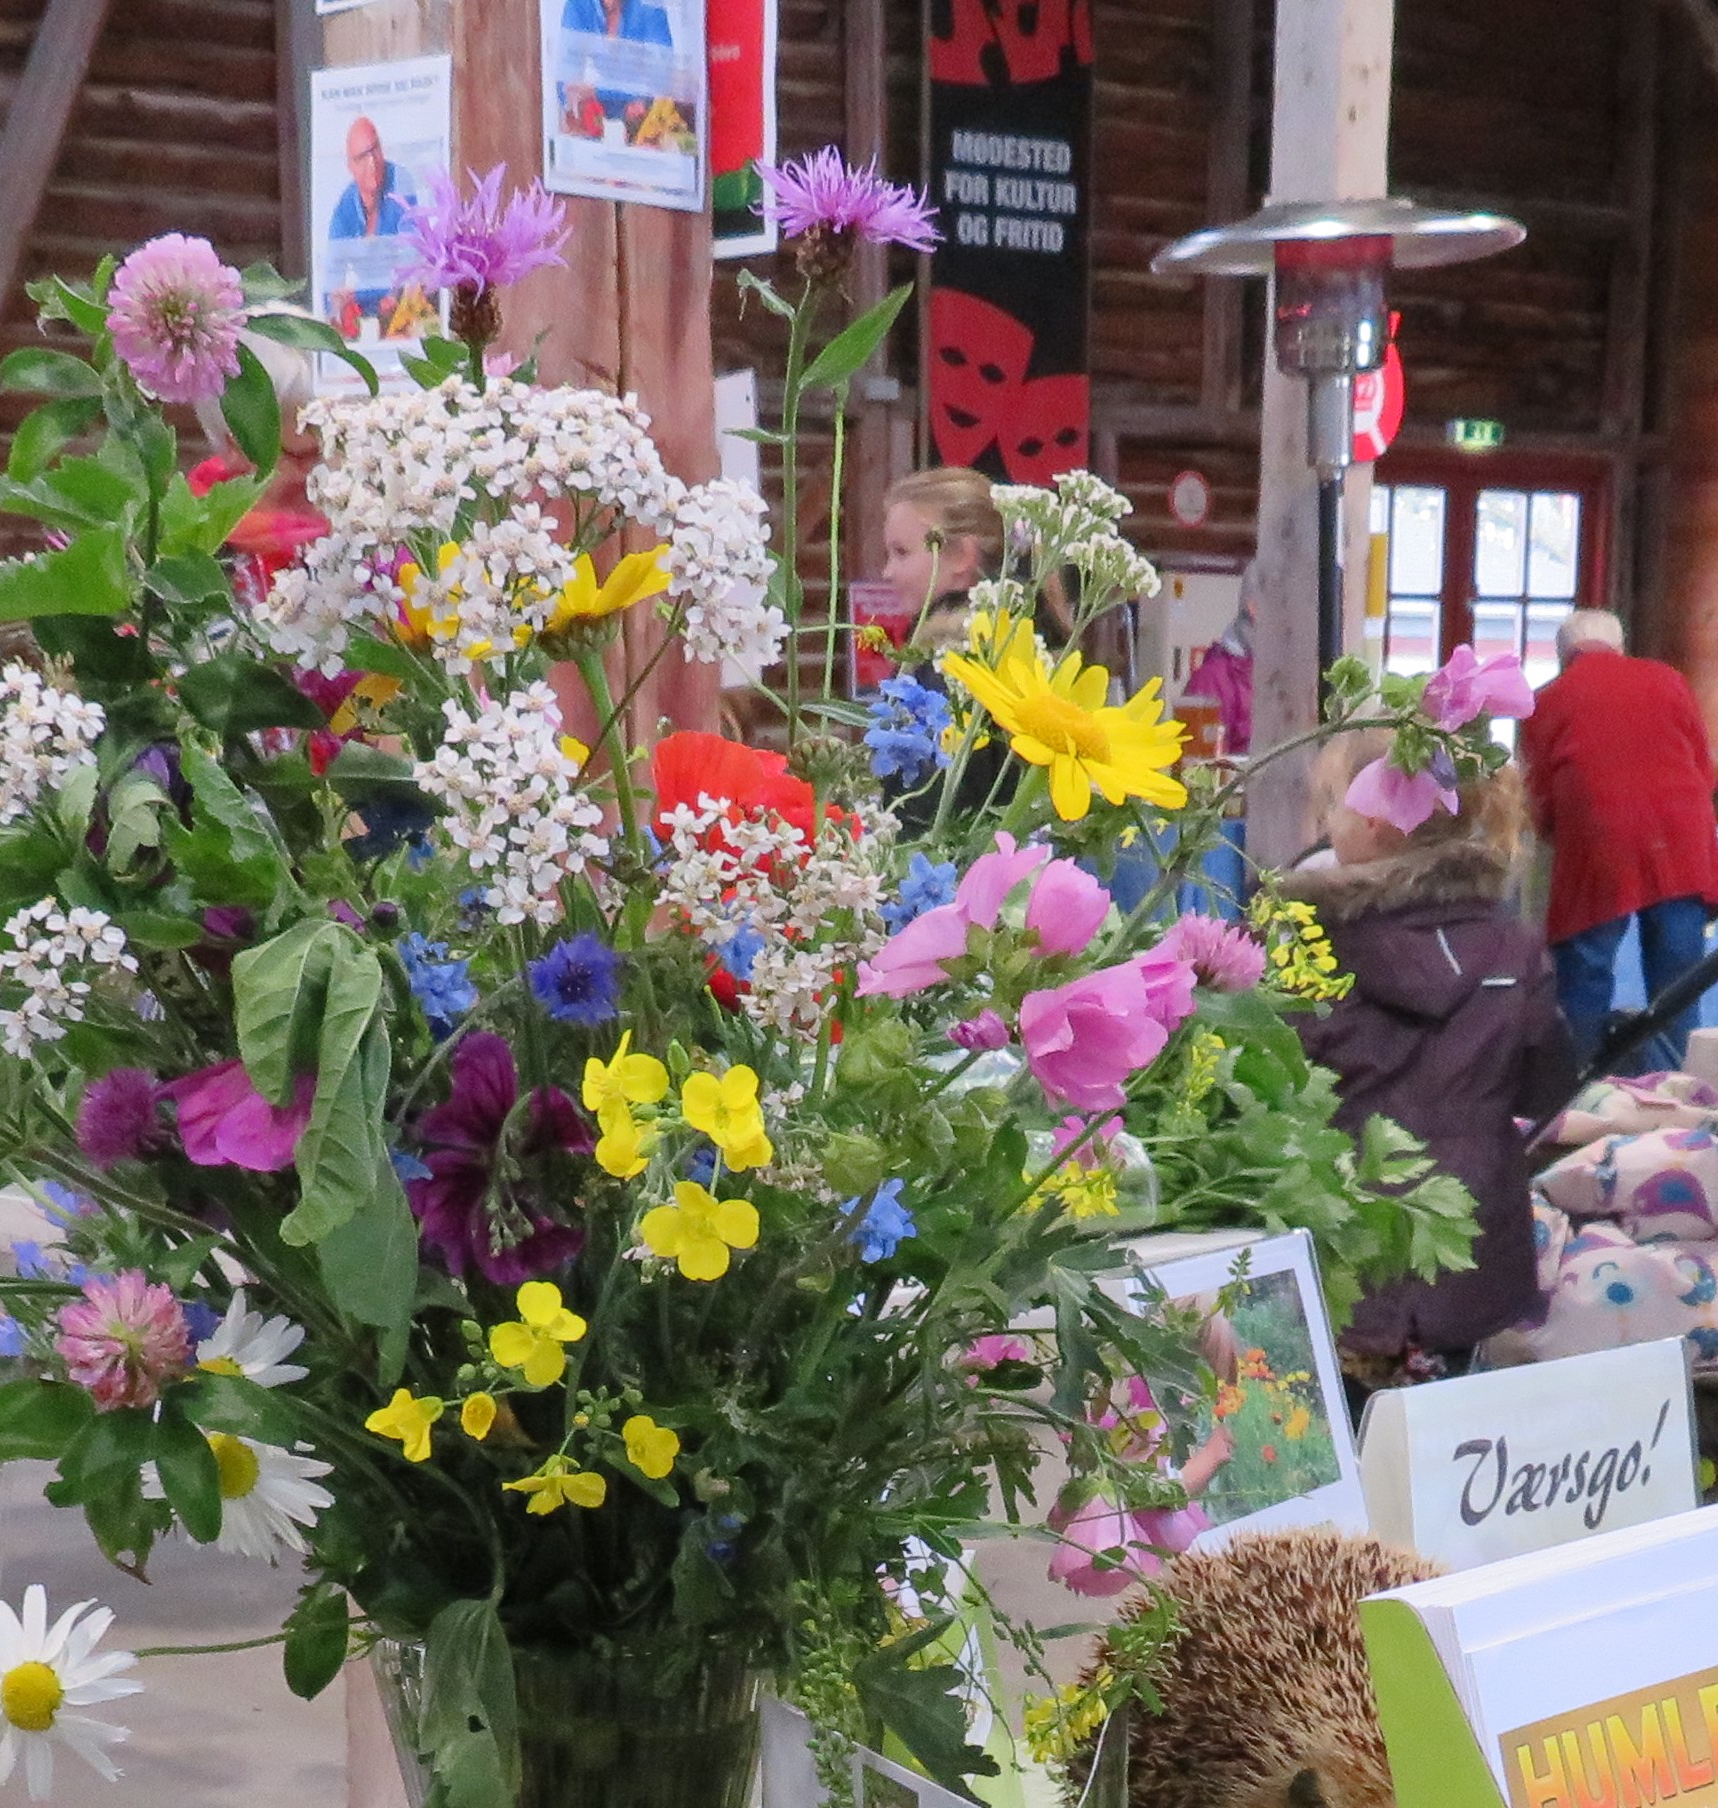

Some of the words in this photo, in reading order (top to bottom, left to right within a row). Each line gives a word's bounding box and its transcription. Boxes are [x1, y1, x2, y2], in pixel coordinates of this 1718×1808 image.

[945, 169, 989, 206] FOR
[995, 177, 1077, 215] KULTUR
[957, 213, 988, 245] OG
[1453, 1398, 1670, 1530] Værsgo!
